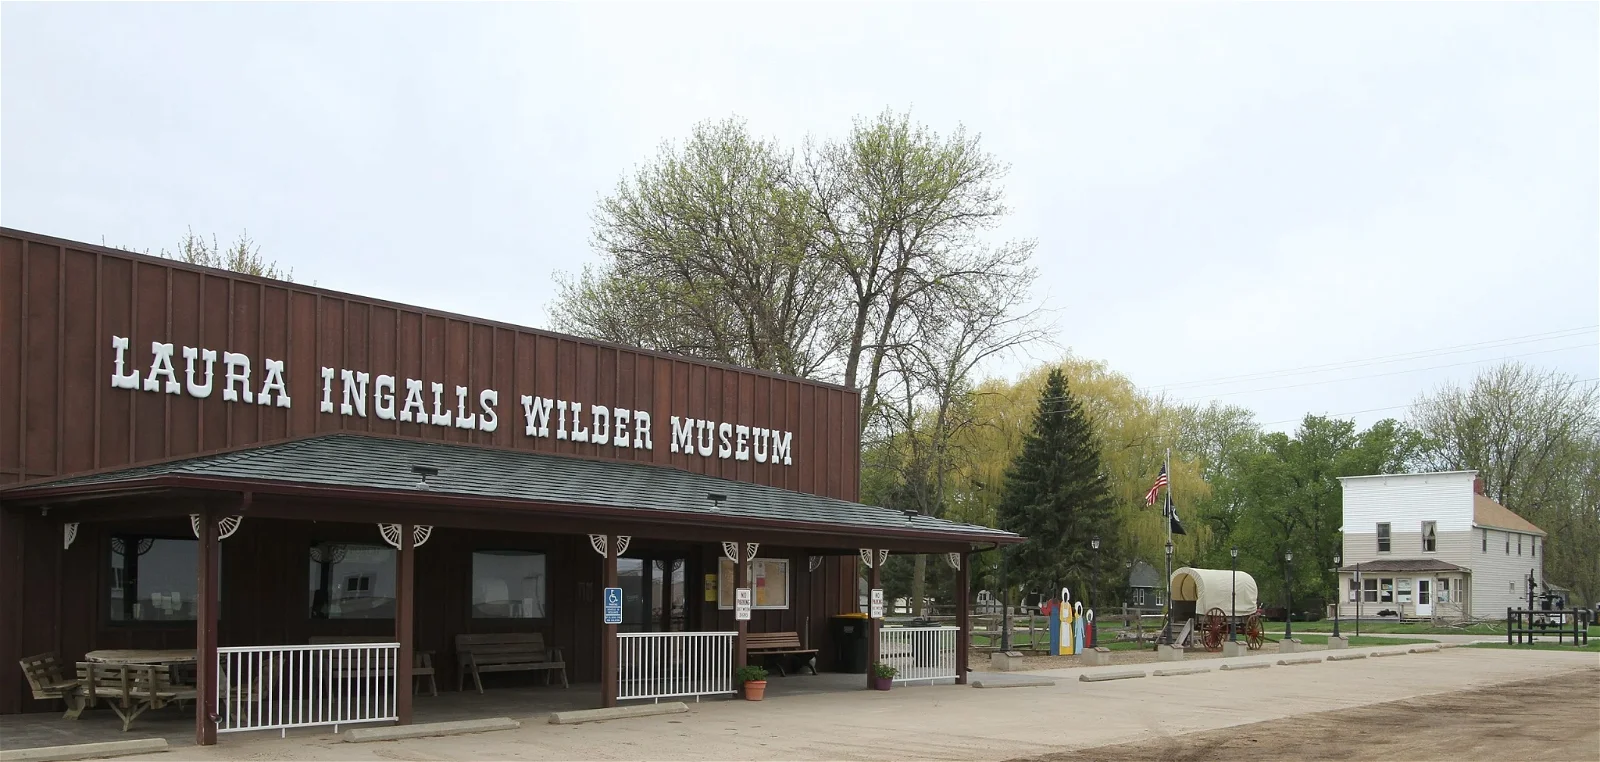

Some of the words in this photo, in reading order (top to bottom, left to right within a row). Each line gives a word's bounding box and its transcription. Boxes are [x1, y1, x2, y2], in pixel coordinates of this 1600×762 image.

[112, 335, 291, 408] LAURA
[320, 366, 498, 433] INGALLS
[521, 395, 652, 449] WILDER
[670, 415, 792, 465] MUSEUM
